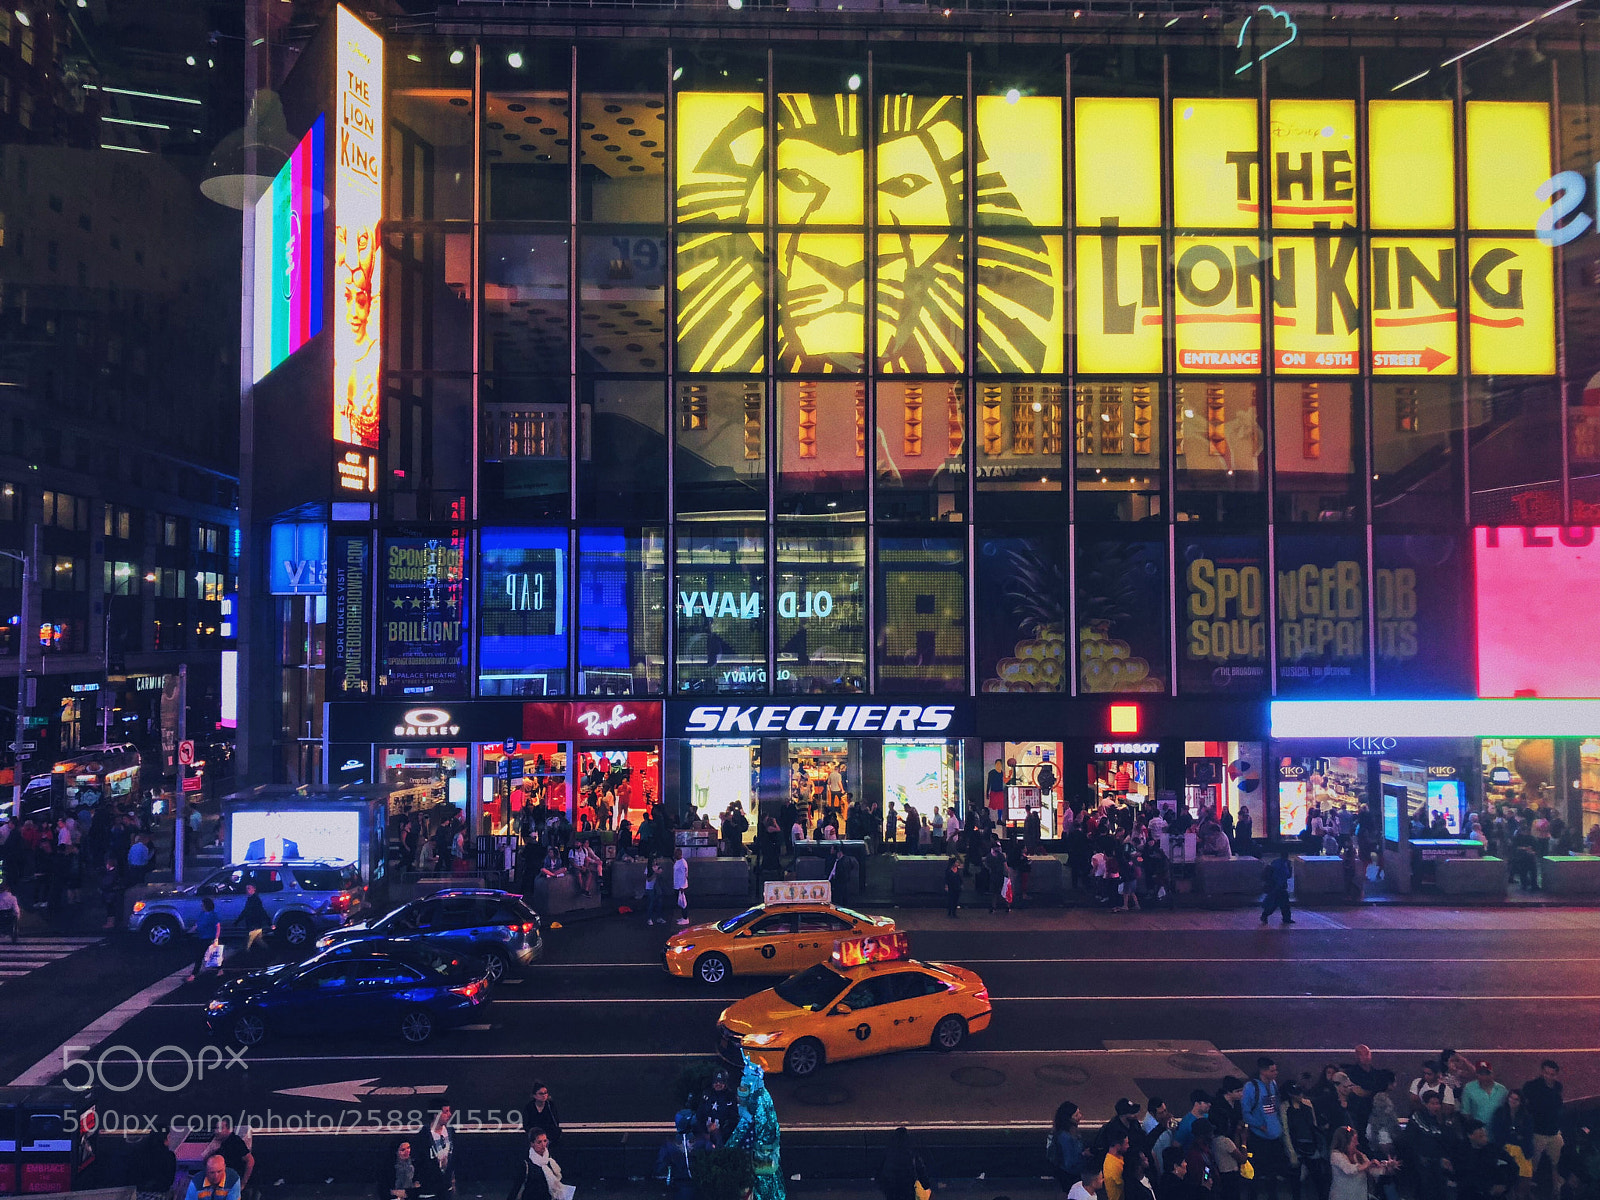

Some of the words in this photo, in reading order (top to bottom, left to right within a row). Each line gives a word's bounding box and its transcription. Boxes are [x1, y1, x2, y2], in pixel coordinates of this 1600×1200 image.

[347, 70, 369, 101] THE
[343, 91, 374, 135] LION
[340, 126, 378, 177] KING
[1225, 149, 1355, 202] THE
[1100, 216, 1297, 335] LION
[1313, 221, 1524, 336] KING
[1184, 353, 1258, 365] ENTRANCE
[1281, 353, 1306, 365] ON
[1315, 353, 1353, 366] 45TH
[1374, 354, 1422, 366] STREET
[336, 568, 345, 592] VISIT
[1188, 558, 1418, 620] SPONGEBOB
[336, 596, 344, 635] TICKETS
[388, 621, 460, 642] BRILLIANT
[336, 638, 344, 659] FOR
[394, 726, 460, 736] OAKLEY
[685, 705, 955, 732] SKECHERS
[1348, 737, 1397, 750] KIKO
[1428, 766, 1456, 774] KIKO
